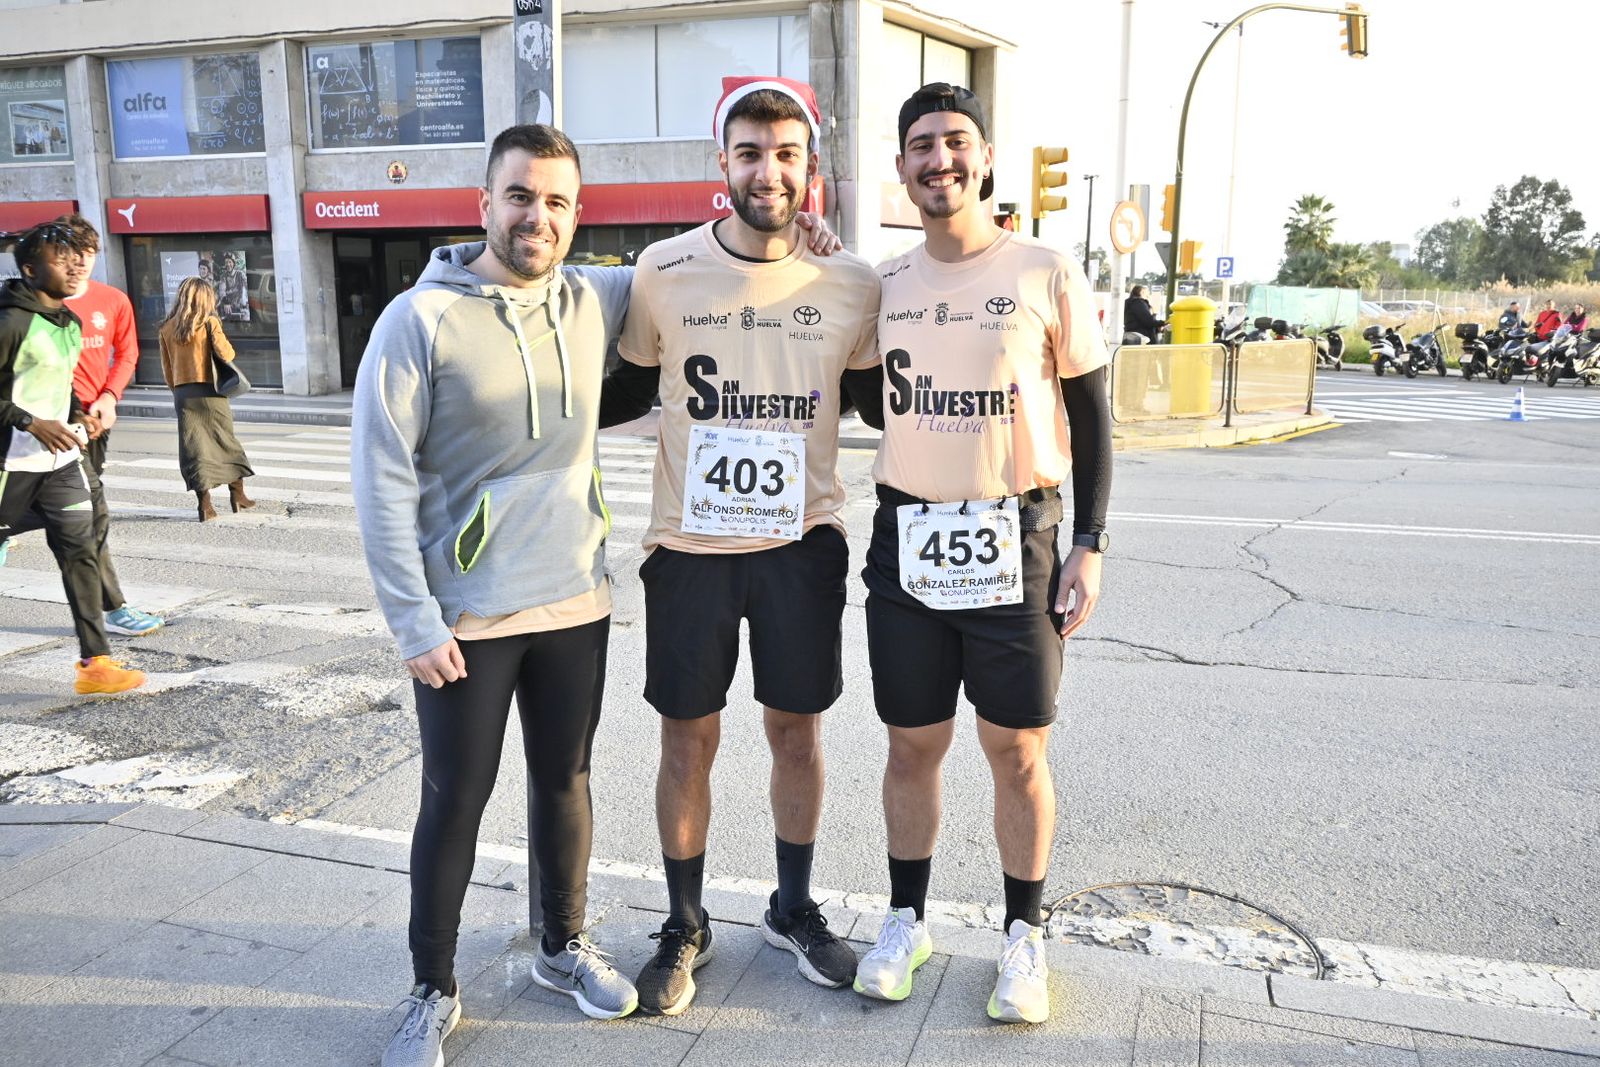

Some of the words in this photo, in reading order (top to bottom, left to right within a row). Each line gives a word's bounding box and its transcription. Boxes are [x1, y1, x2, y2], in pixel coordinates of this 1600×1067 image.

[123, 92, 167, 112] alfa
[315, 200, 380, 218] Occident
[656, 256, 685, 272] luanvi
[1219, 258, 1231, 276] P
[682, 313, 728, 327] Huelva
[886, 309, 924, 324] Huelva
[949, 314, 974, 323] HUELVA
[756, 321, 782, 329] HUELVA
[980, 321, 1019, 332] HUELVA
[788, 331, 824, 342] HUELVA
[916, 402, 984, 434] Huelva
[704, 456, 785, 497] 403
[731, 496, 757, 504] ADRIAN
[694, 503, 744, 516] ALFONSO
[747, 507, 794, 519] ROMERO
[918, 528, 1000, 568] 453
[947, 568, 976, 576] CARLOS
[907, 579, 966, 590] GONZALEZ
[968, 574, 1018, 588] RAMIREZ
